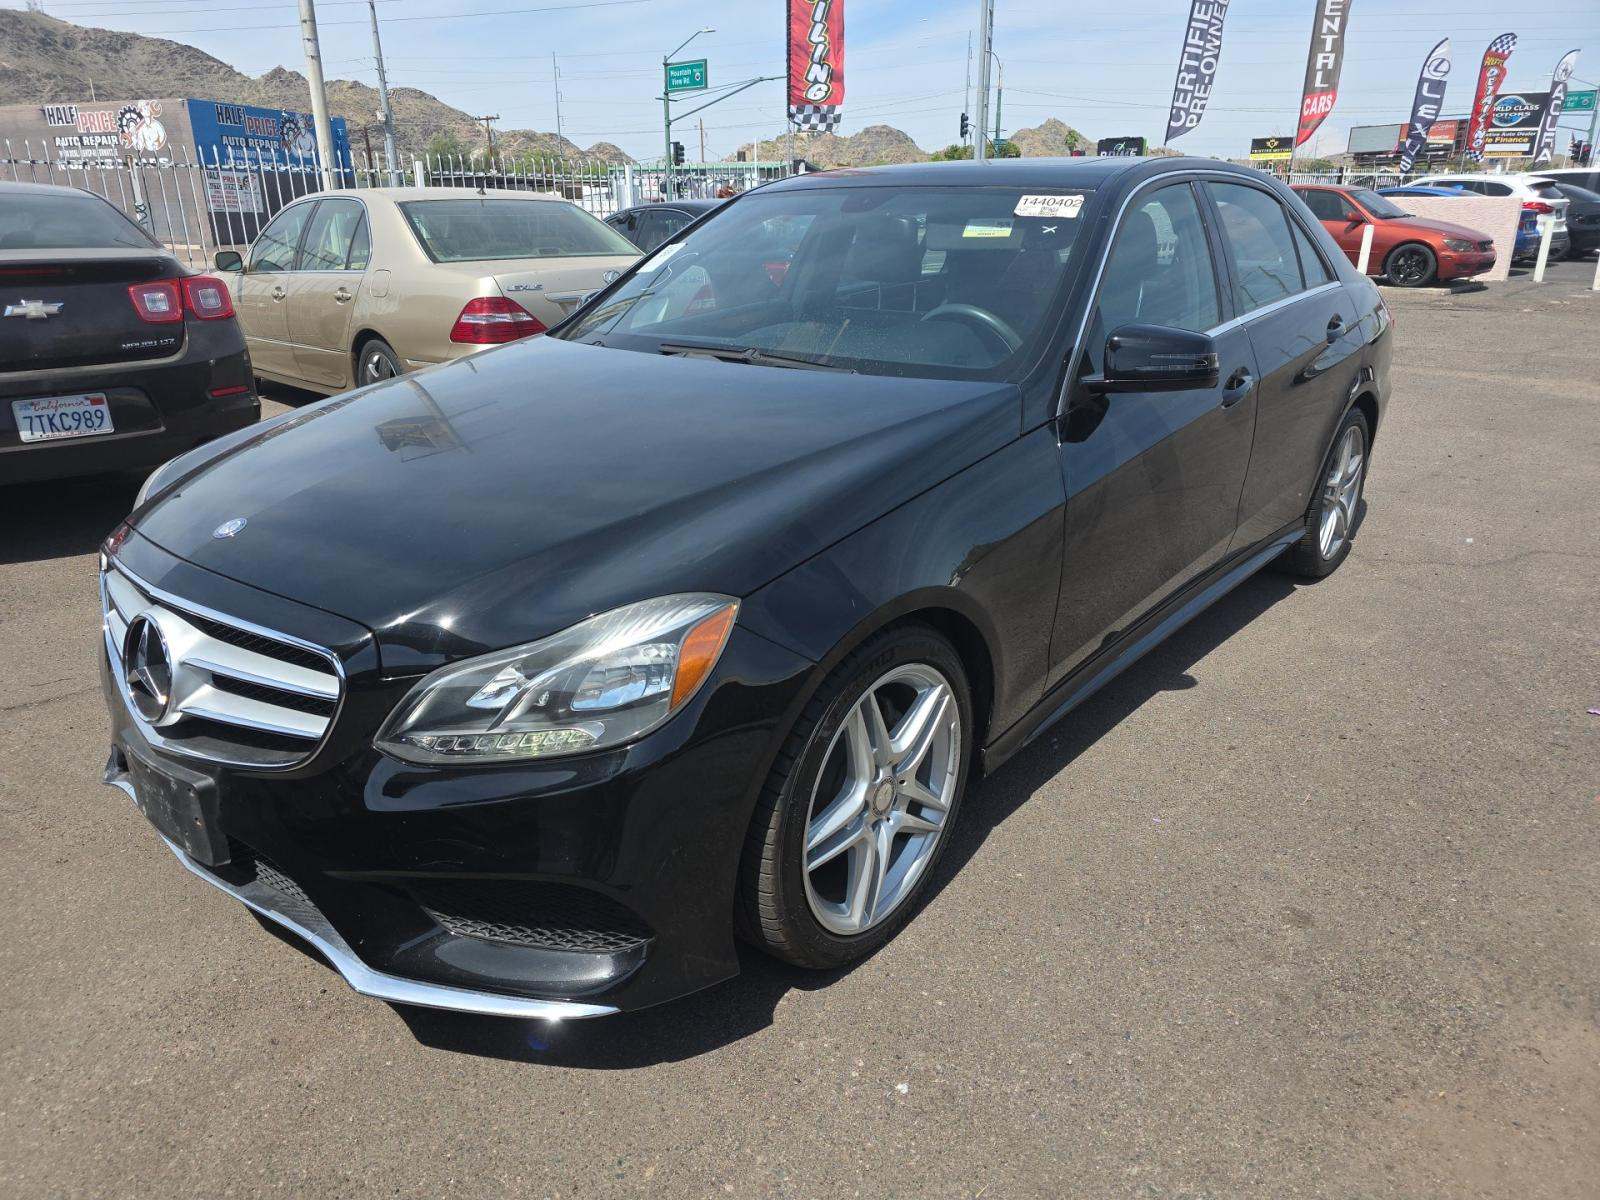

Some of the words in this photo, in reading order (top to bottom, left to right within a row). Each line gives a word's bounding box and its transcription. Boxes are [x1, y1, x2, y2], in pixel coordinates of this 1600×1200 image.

[805, 0, 831, 102] ILING
[1314, 0, 1345, 88] ENTAL
[1170, 0, 1216, 127] CERTIFIE
[46, 105, 76, 125] HALF
[216, 105, 244, 126] HALF
[1303, 94, 1333, 116] CARS
[79, 111, 117, 132] PRICE
[246, 117, 278, 137] PRICE
[1399, 82, 1441, 172] LEXUS
[1535, 83, 1565, 162] ACURA
[56, 136, 80, 147] AUTO
[82, 135, 118, 146] REPAIR
[223, 136, 246, 147] AUTO
[248, 138, 279, 149] REPAIR
[1023, 197, 1083, 208] 1440402
[33, 399, 89, 412] California
[23, 409, 105, 436] 7TKC989
